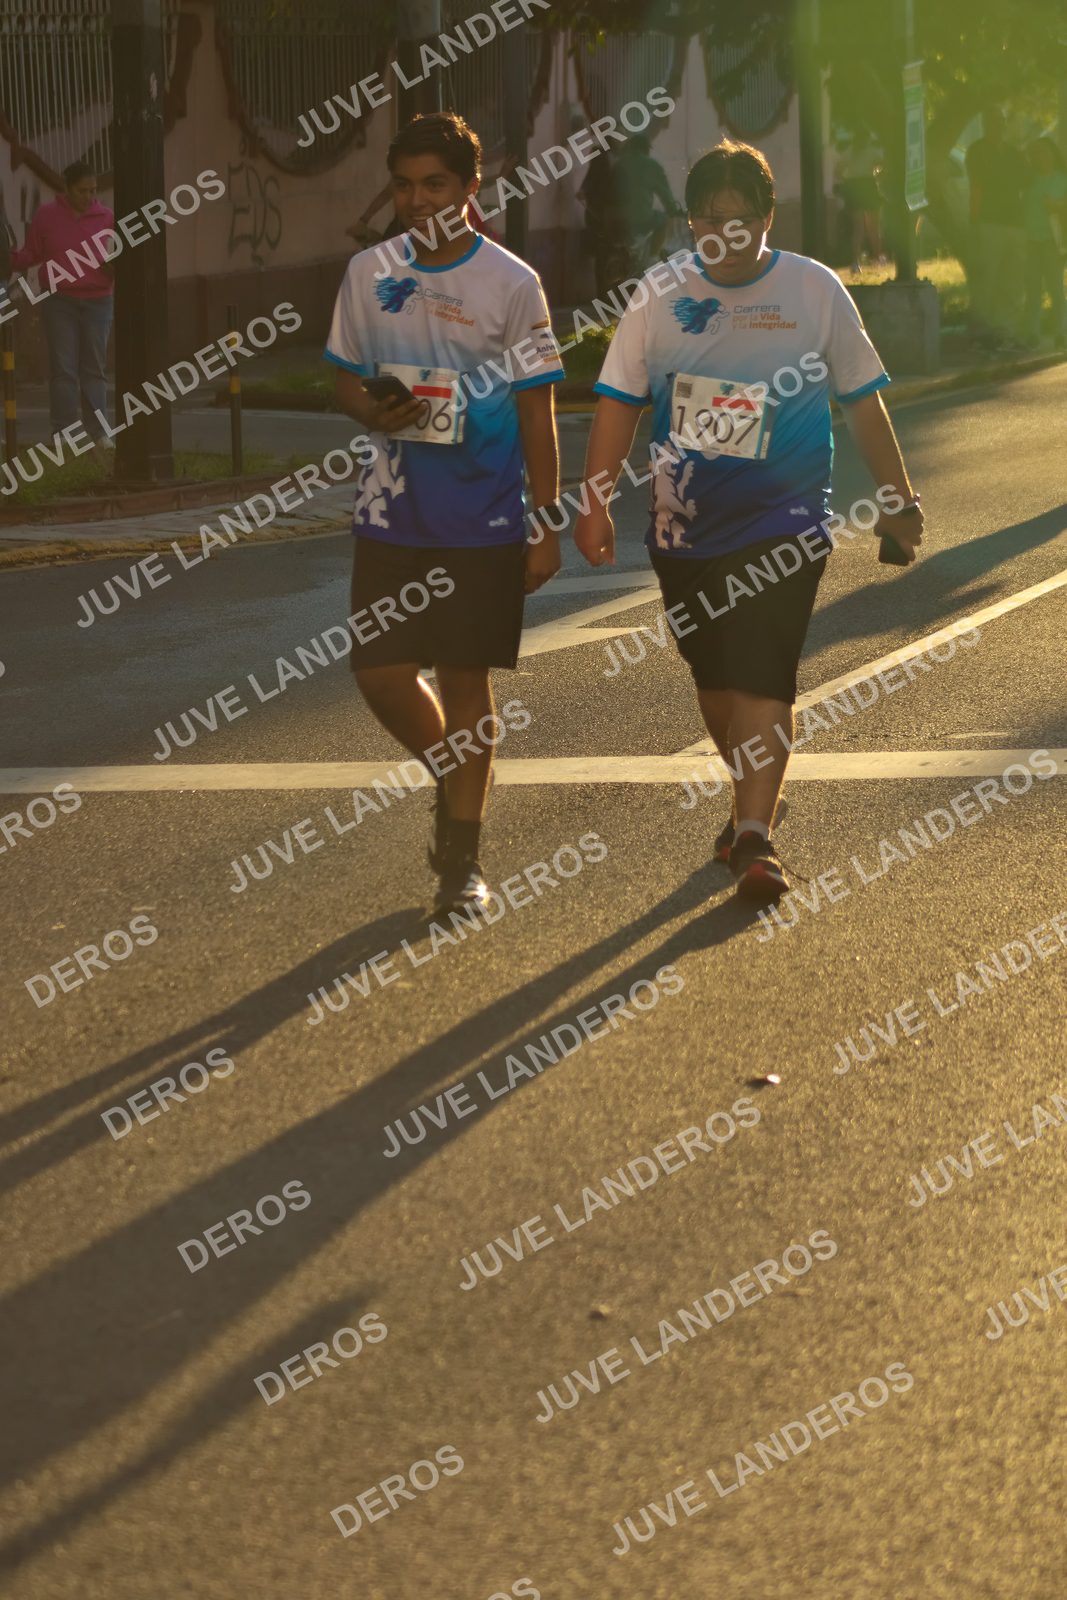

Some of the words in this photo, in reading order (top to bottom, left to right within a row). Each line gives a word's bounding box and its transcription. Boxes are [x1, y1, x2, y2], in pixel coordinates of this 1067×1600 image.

[734, 305, 781, 314] Carrera
[760, 312, 781, 321] Vida
[749, 320, 797, 331] Integridad
[415, 399, 452, 433] 06
[677, 405, 760, 446] 1907
